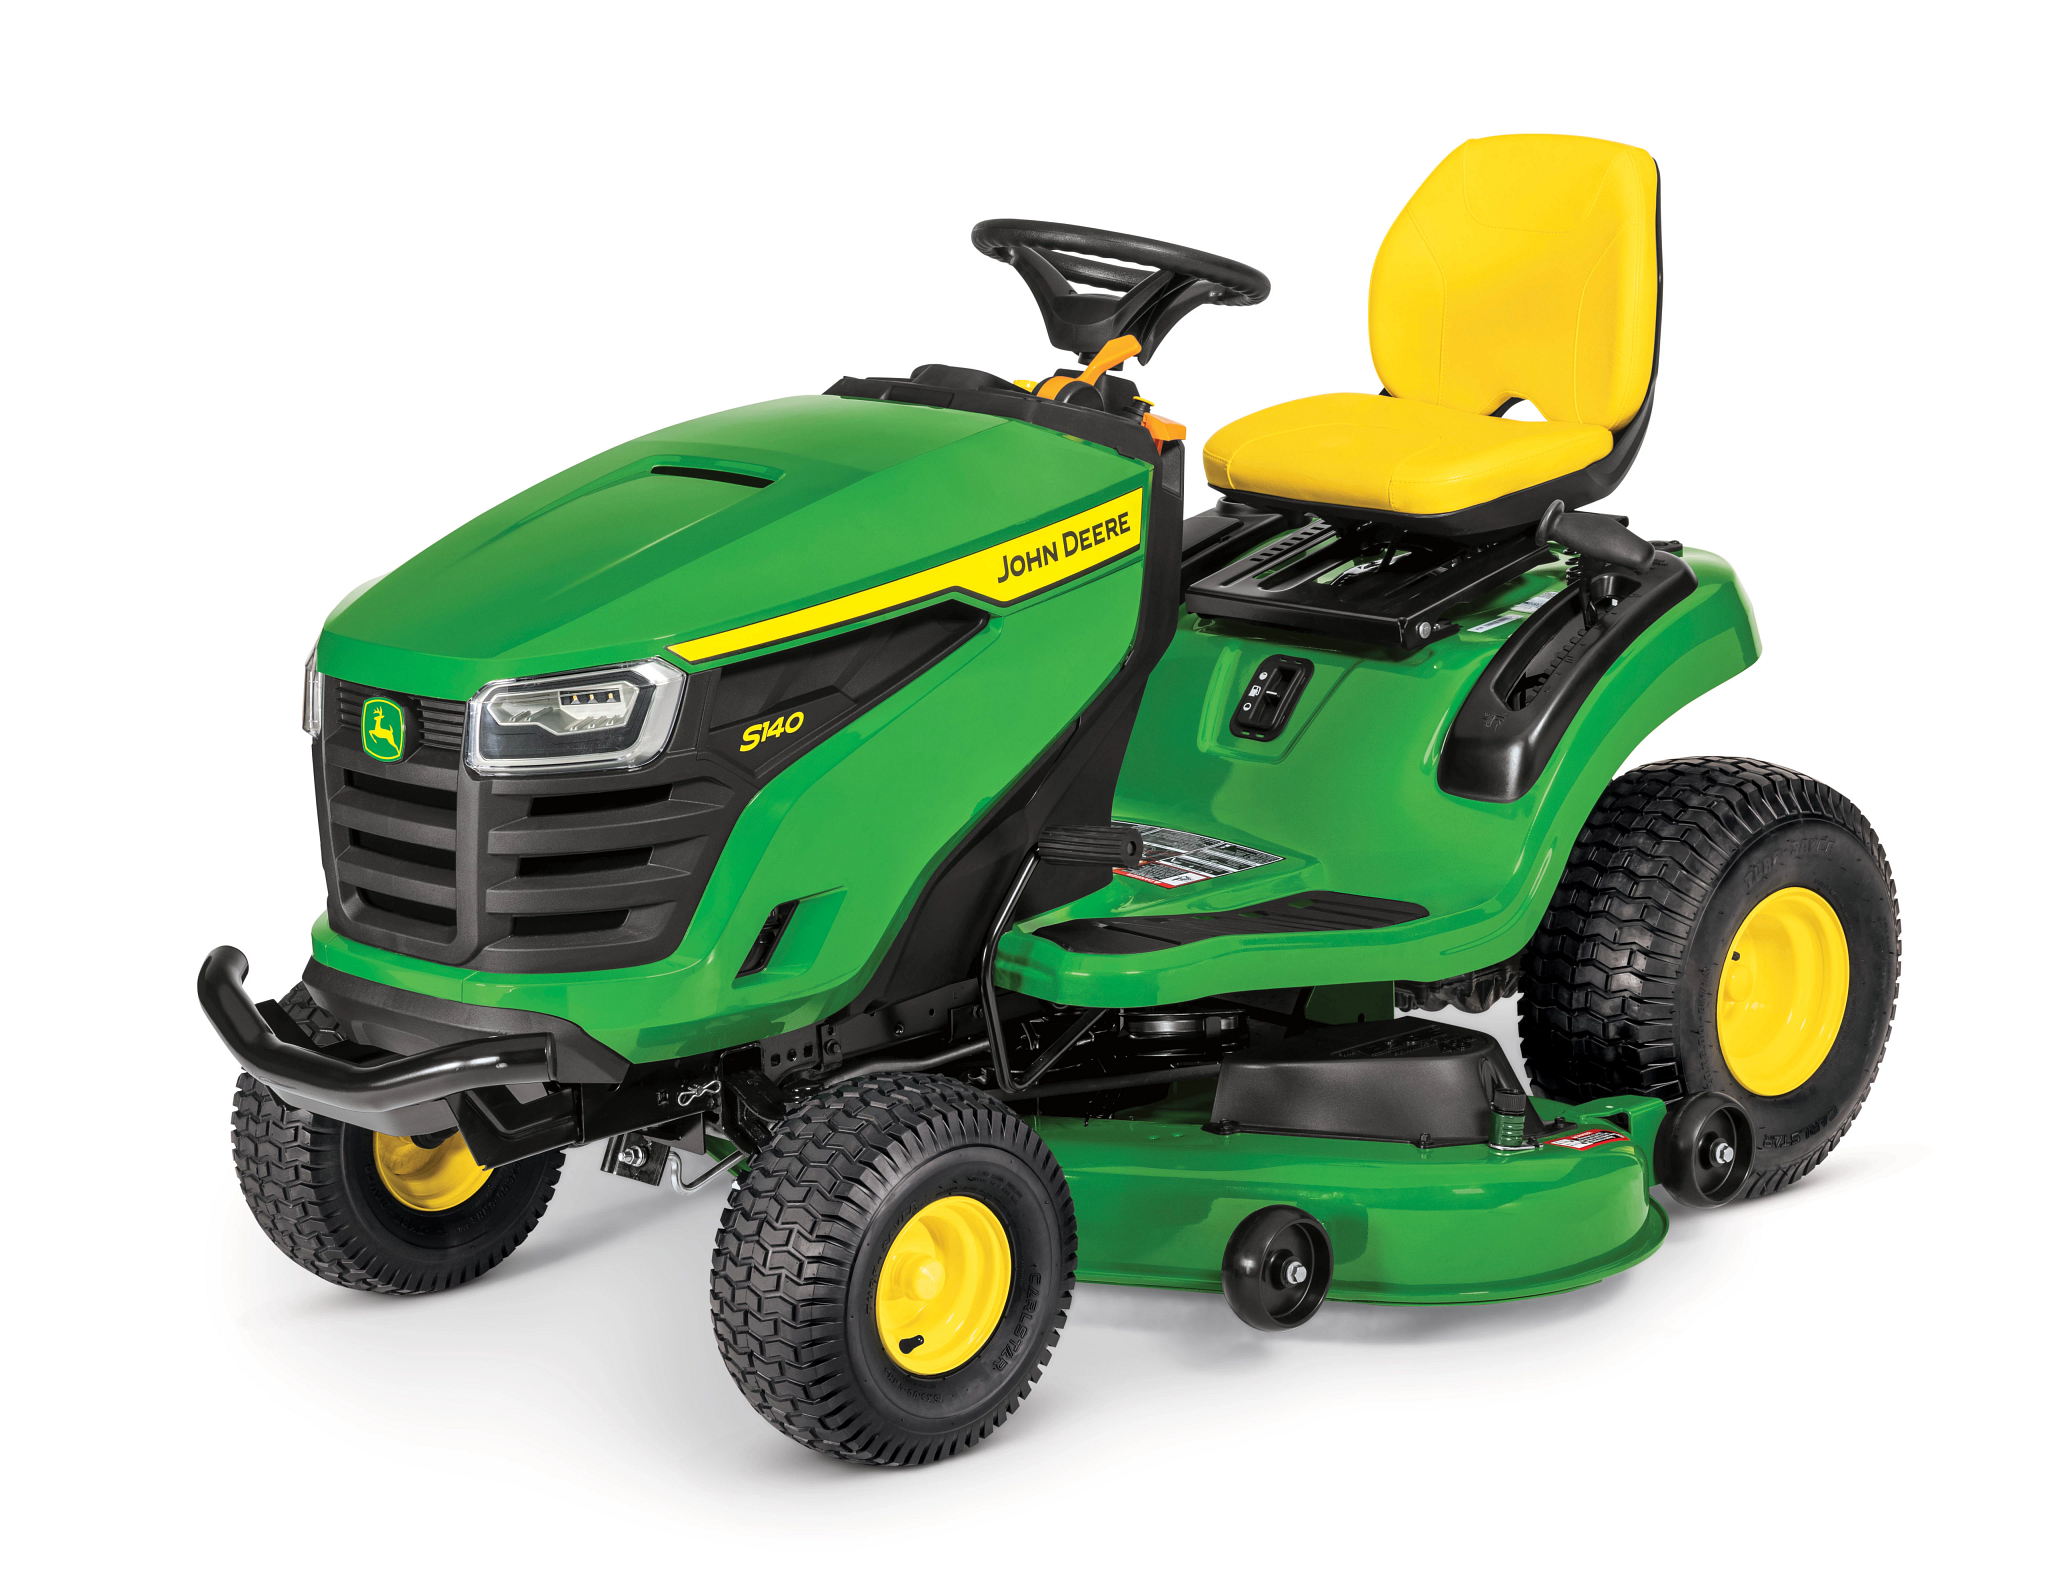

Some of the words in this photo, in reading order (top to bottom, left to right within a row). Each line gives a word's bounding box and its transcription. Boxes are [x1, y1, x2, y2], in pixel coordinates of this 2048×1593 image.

[997, 541, 1059, 584] JOHN
[1062, 511, 1131, 558] DEERE
[739, 711, 805, 752] S140
[1762, 1104, 1838, 1149] CARLSTAR
[993, 1272, 1042, 1373] CARLSTAR
